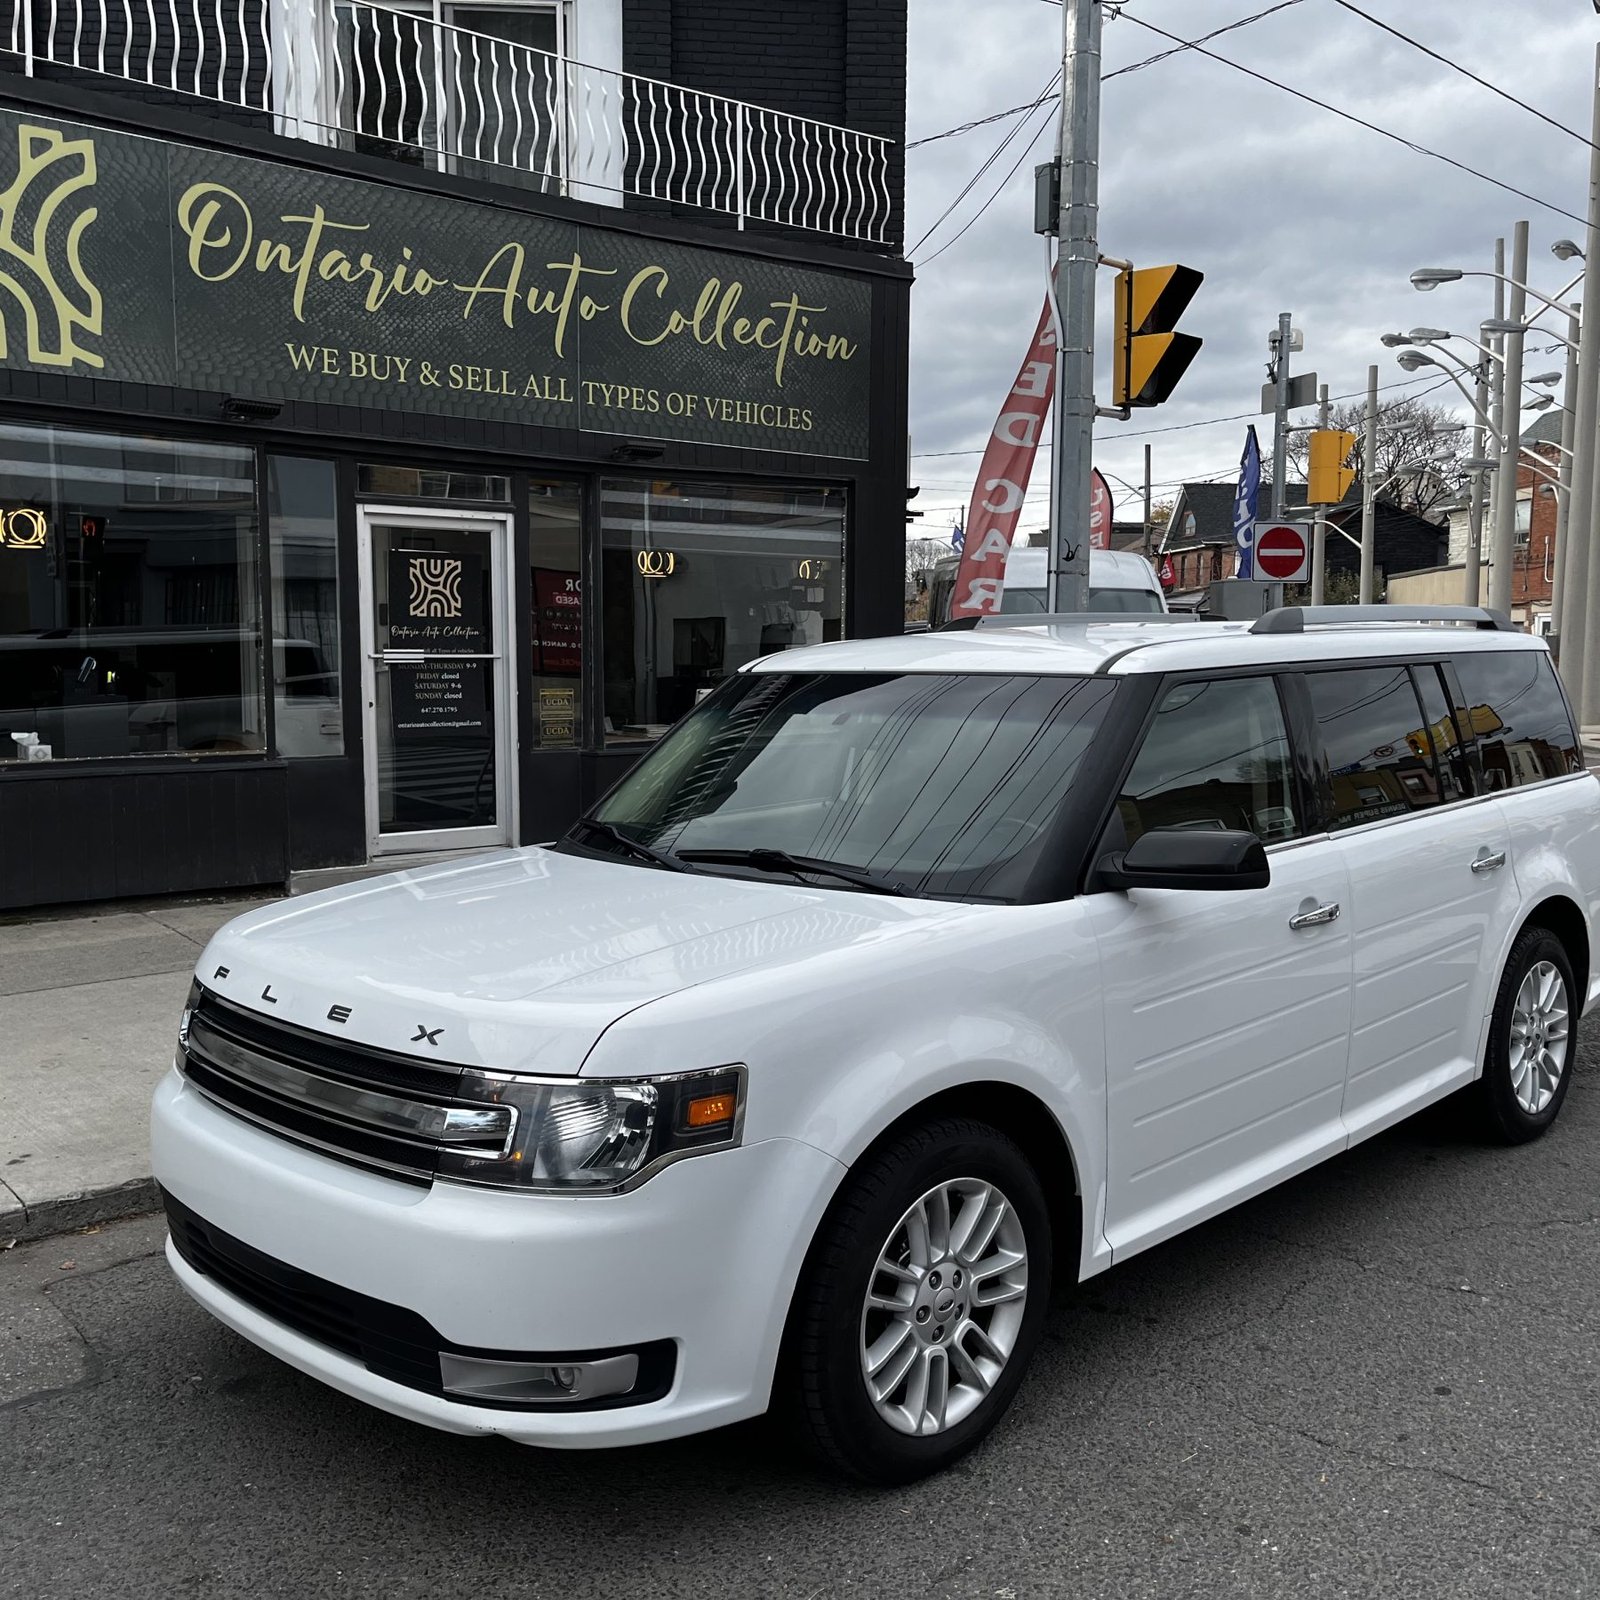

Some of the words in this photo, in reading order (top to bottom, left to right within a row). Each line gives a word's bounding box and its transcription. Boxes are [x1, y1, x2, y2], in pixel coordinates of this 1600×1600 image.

[178, 183, 447, 323] Ontario
[453, 242, 618, 359] Auto
[620, 265, 858, 388] Collection
[285, 343, 341, 376] WE
[350, 351, 413, 385] BUY
[420, 360, 442, 388] &
[448, 364, 519, 397] SELL
[524, 374, 574, 404] ALL
[581, 381, 661, 413] TYPES
[666, 392, 699, 417] OF
[703, 396, 813, 431] VEHICLES
[421, 625, 442, 639] Auto
[443, 625, 480, 639] Collection
[416, 672, 441, 680] FRIDAY
[414, 682, 449, 690] SATURDAY
[415, 692, 443, 700] SUNDAY
[545, 698, 569, 706] UCDA
[545, 727, 570, 735] UCDA
